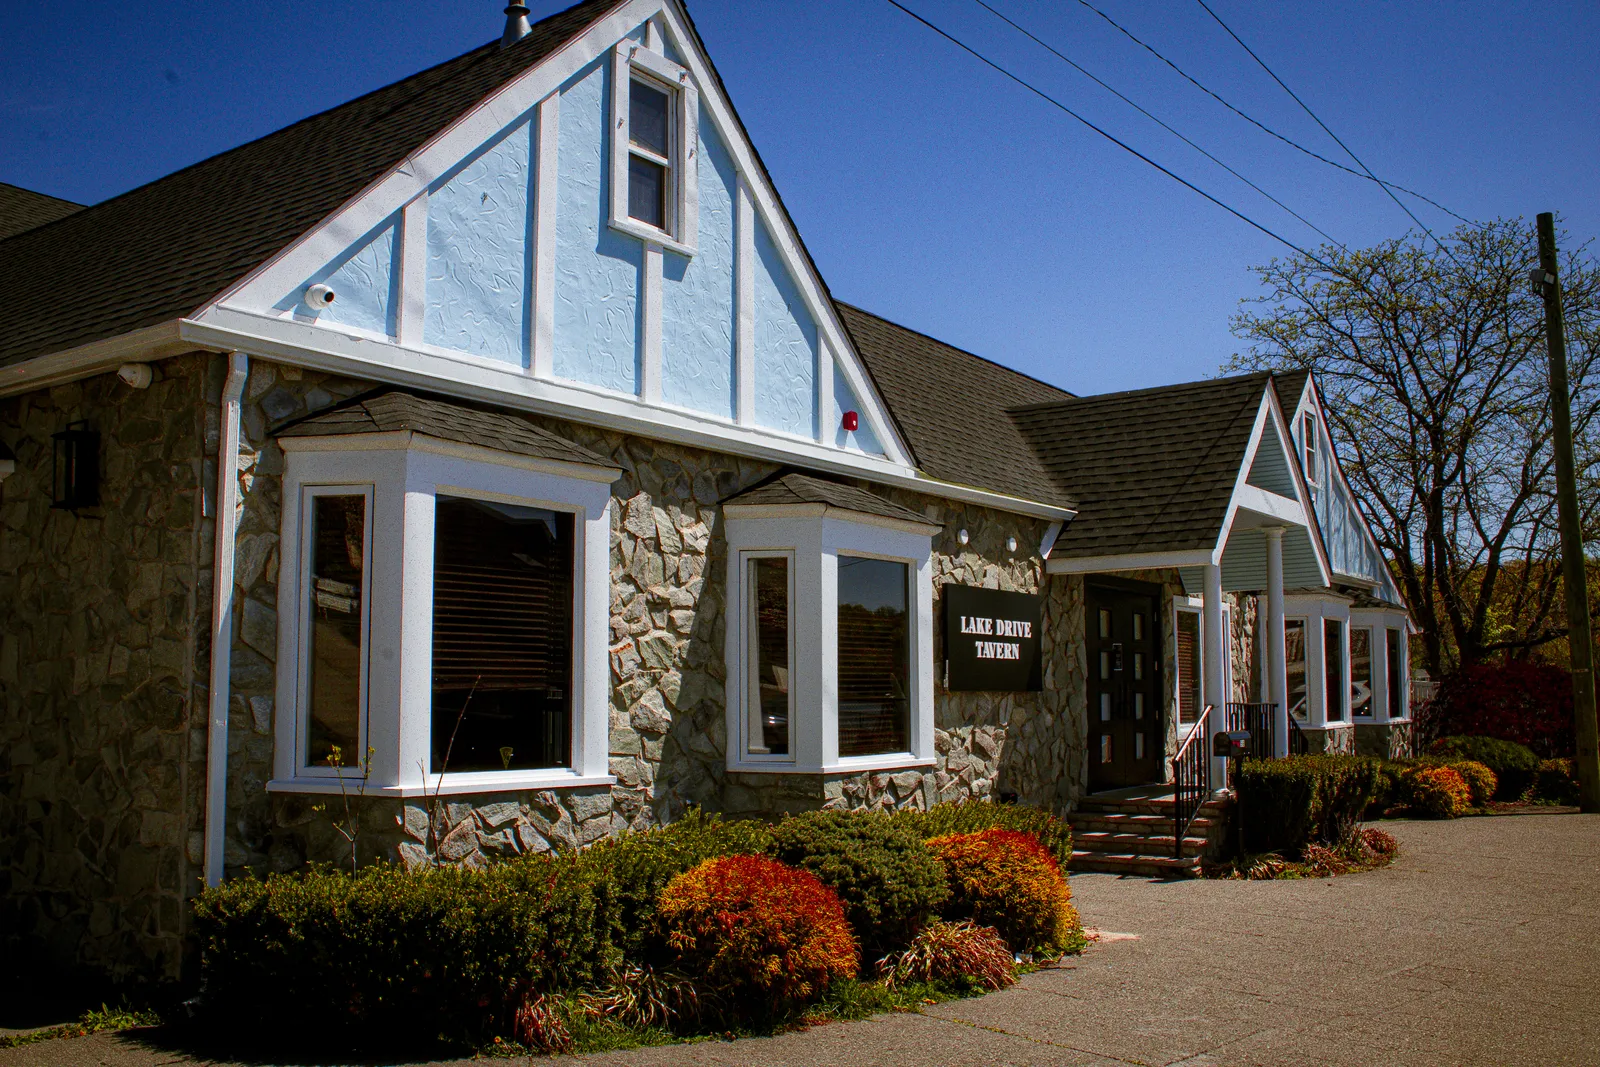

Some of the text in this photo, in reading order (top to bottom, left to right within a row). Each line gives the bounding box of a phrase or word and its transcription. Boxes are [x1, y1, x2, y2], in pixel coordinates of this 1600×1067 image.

[960, 616, 1032, 638] LAKE DRIVE
[975, 641, 1019, 660] TAVERN
